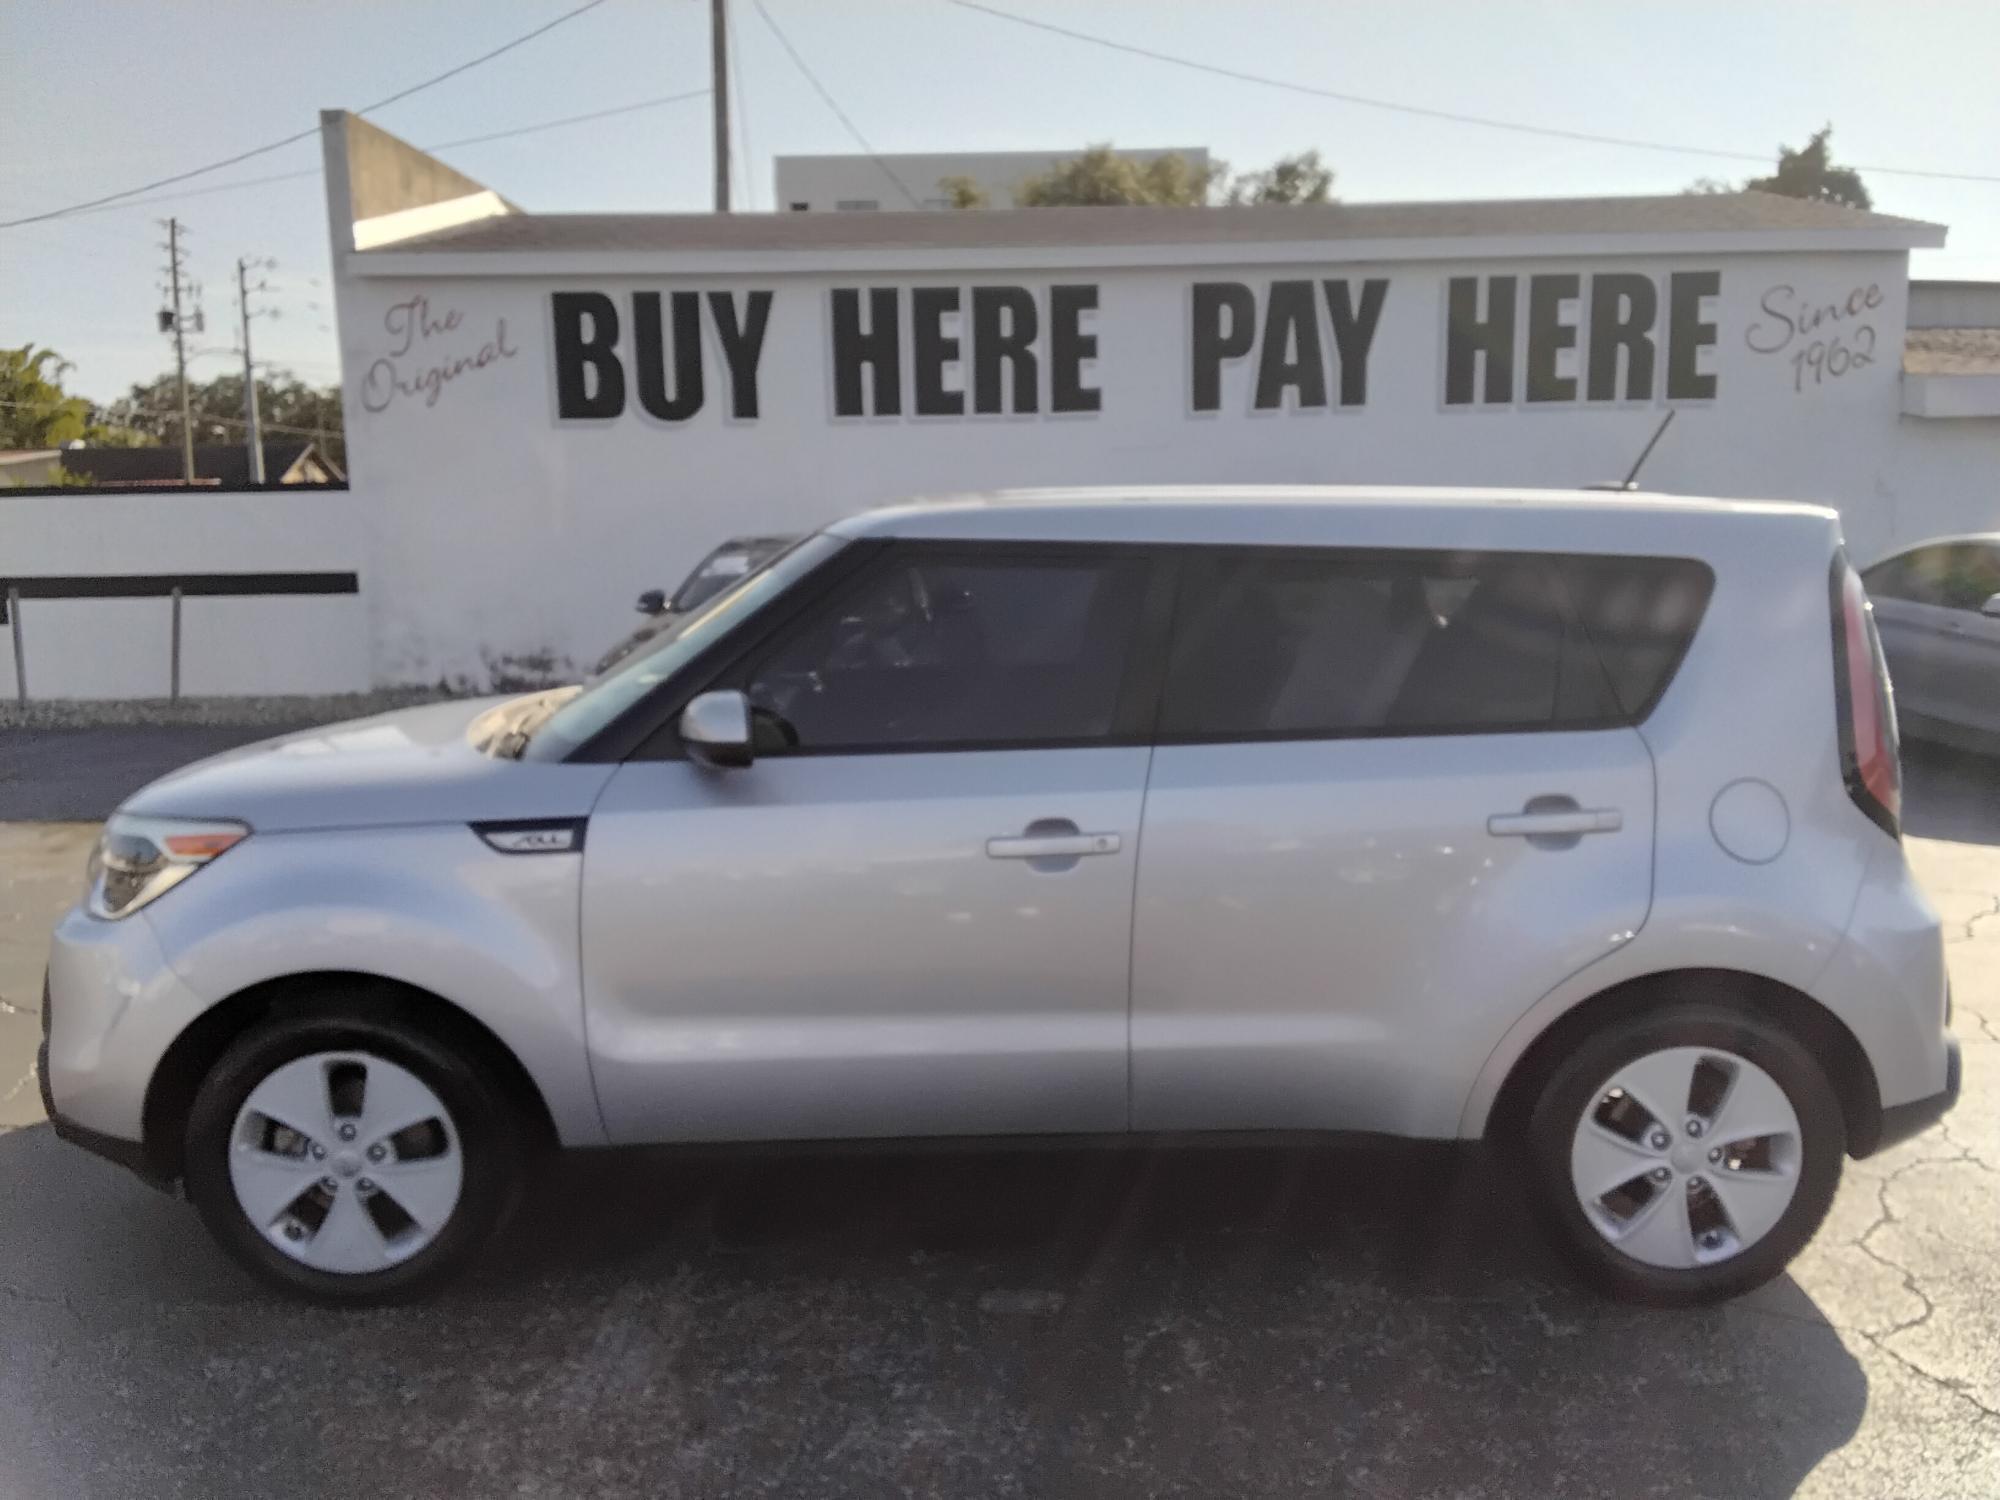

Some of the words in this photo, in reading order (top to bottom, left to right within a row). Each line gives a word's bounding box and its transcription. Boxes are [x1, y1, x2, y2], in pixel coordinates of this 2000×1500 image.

[384, 295, 466, 358] The
[551, 289, 774, 422] BUY
[829, 283, 1101, 418] HERE
[1191, 278, 1390, 412] PAY
[1443, 270, 1722, 406] HERE
[1745, 280, 1885, 356] Since
[360, 317, 519, 414] Original
[1791, 326, 1877, 392] 1962
